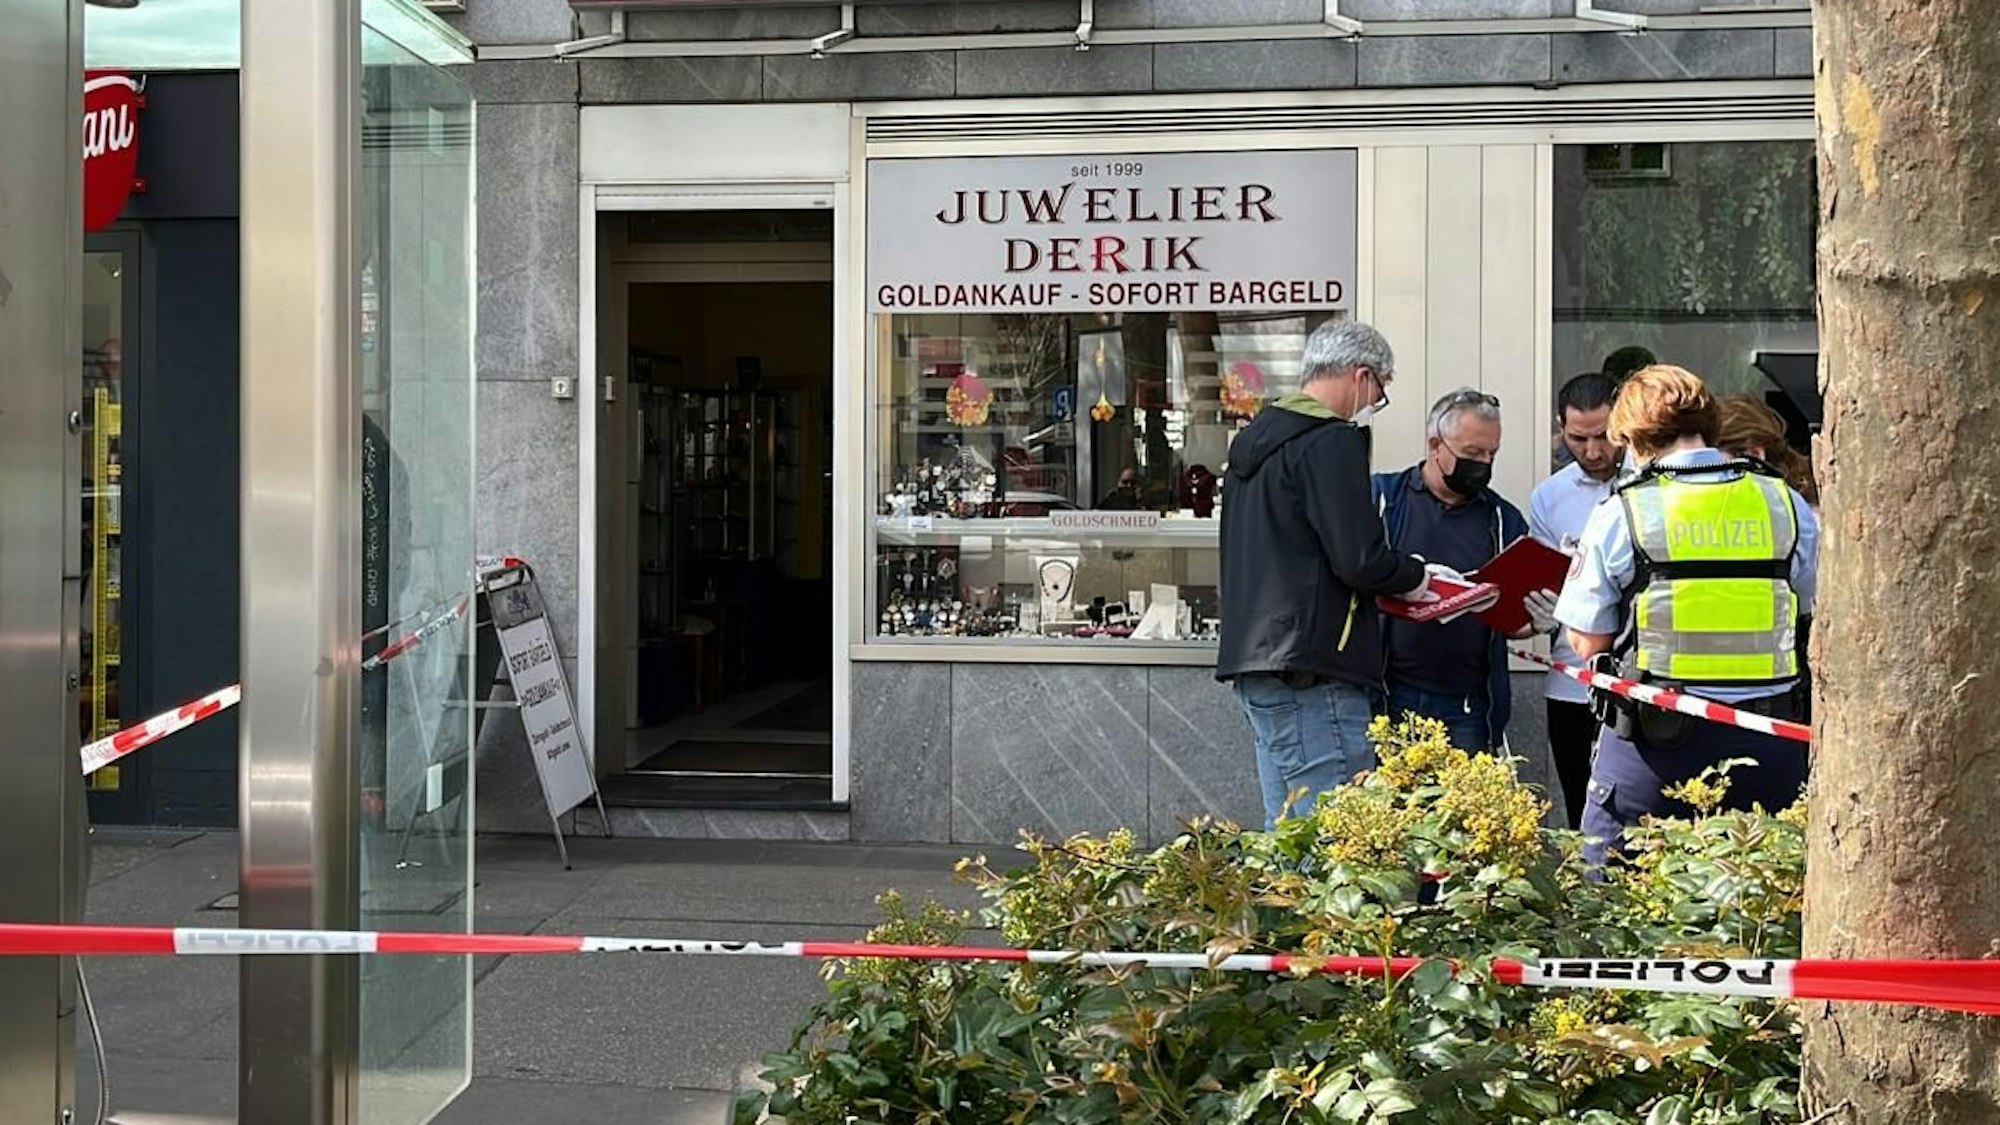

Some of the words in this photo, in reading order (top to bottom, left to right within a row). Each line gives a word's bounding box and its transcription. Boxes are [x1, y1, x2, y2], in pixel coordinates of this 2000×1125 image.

[1071, 164, 1099, 177] seit
[1106, 163, 1143, 176] 1999
[935, 181, 1282, 223] JUWELIER
[1003, 236, 1209, 274] DERIK
[878, 283, 1062, 307] GOLDANKAUF
[1088, 282, 1200, 305] SOFORT
[1209, 280, 1343, 304] BARGELD
[1051, 515, 1158, 529] GOLDSCHMIED
[1673, 519, 1768, 548] POLIZEI
